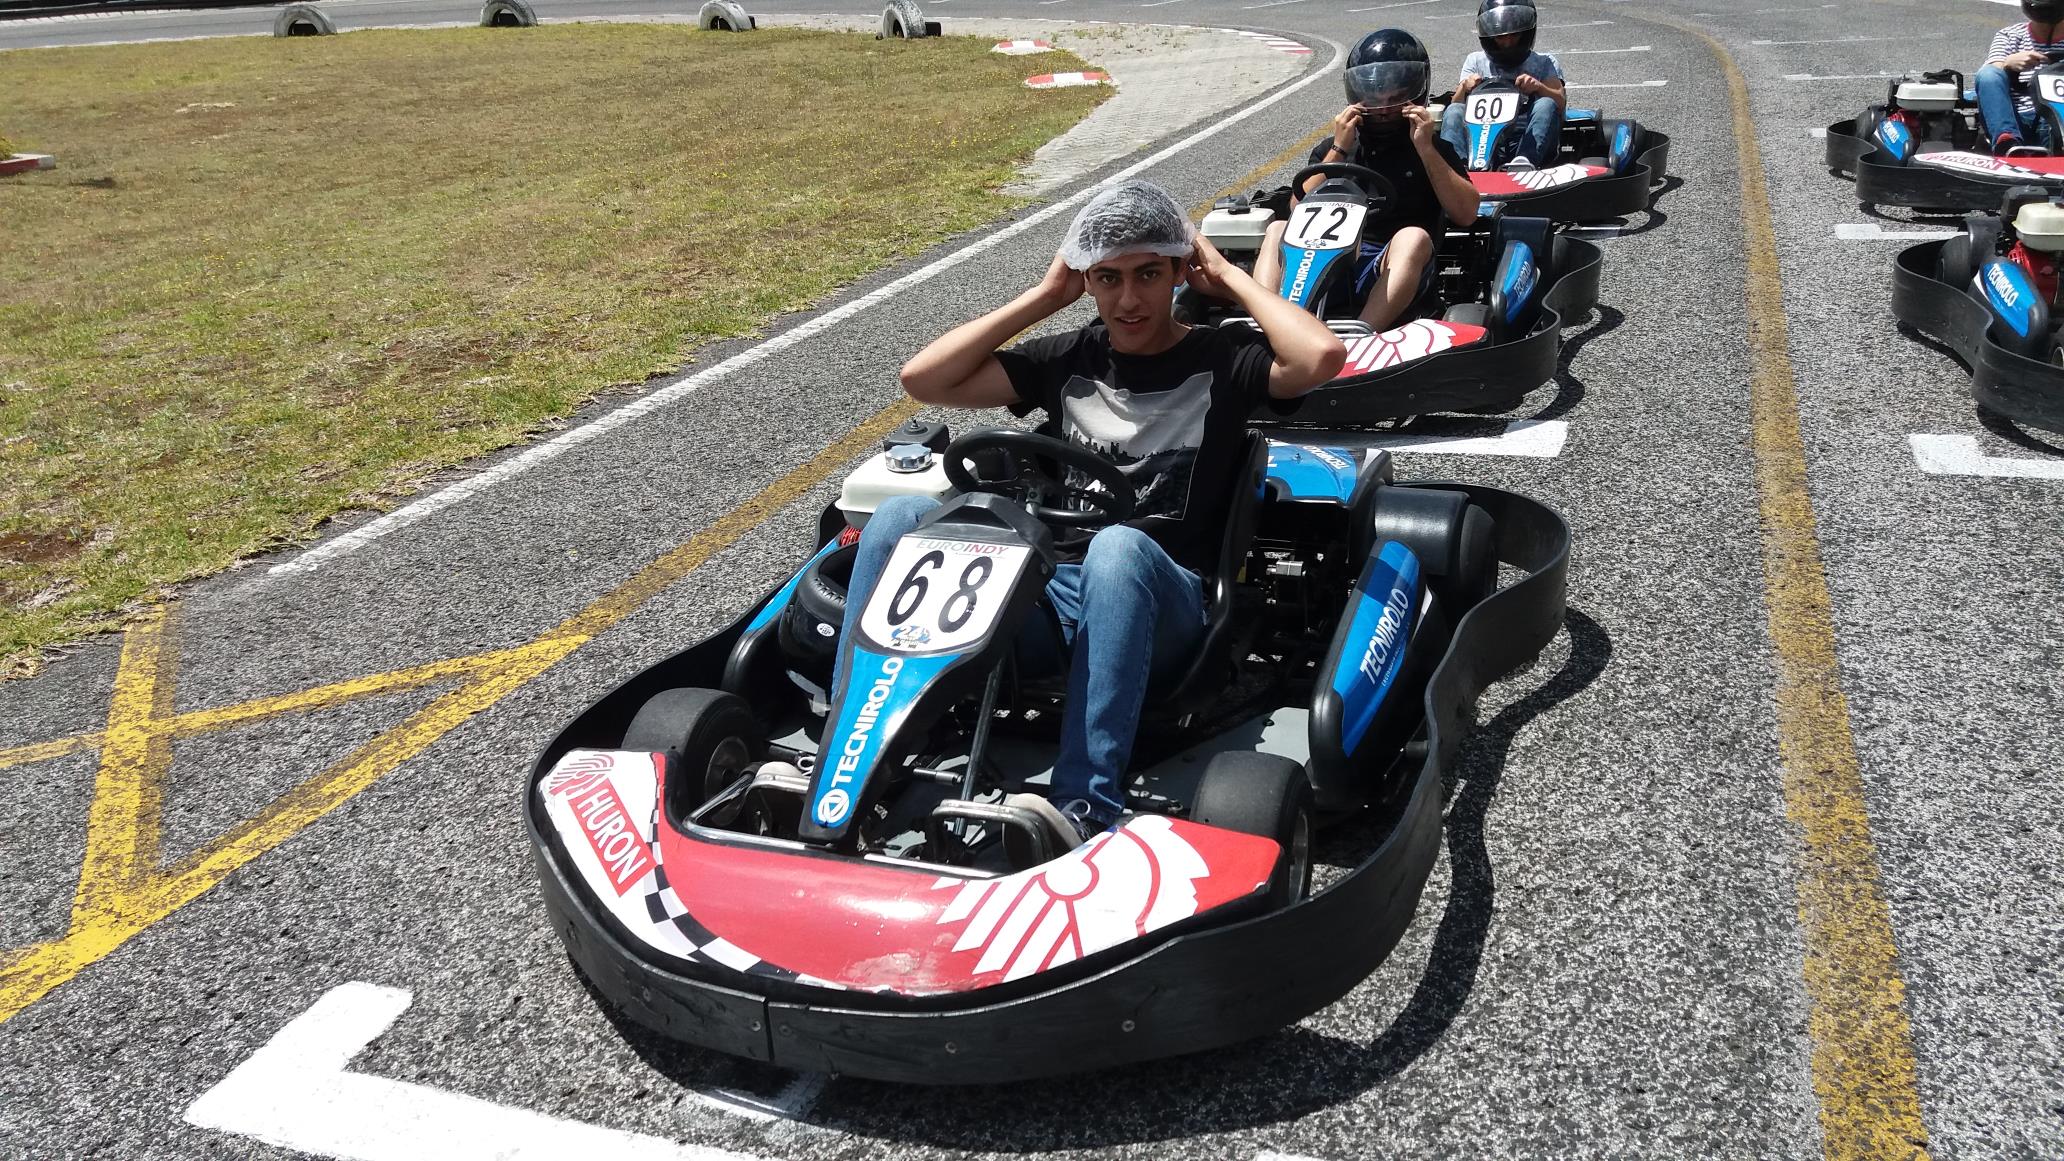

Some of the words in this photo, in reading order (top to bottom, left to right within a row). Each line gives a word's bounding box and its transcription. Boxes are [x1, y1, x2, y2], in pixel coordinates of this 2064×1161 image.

[1474, 96, 1503, 120] 60
[1299, 206, 1348, 241] 72
[1288, 250, 1316, 302] TECNIROLO
[1987, 263, 2020, 307] TECNIROLO
[916, 539, 1009, 555] EUROINDY
[887, 549, 994, 633] 68
[1359, 588, 1409, 685] TECNIROLO
[831, 656, 904, 788] TECNIROLO
[576, 788, 648, 885] HURON
